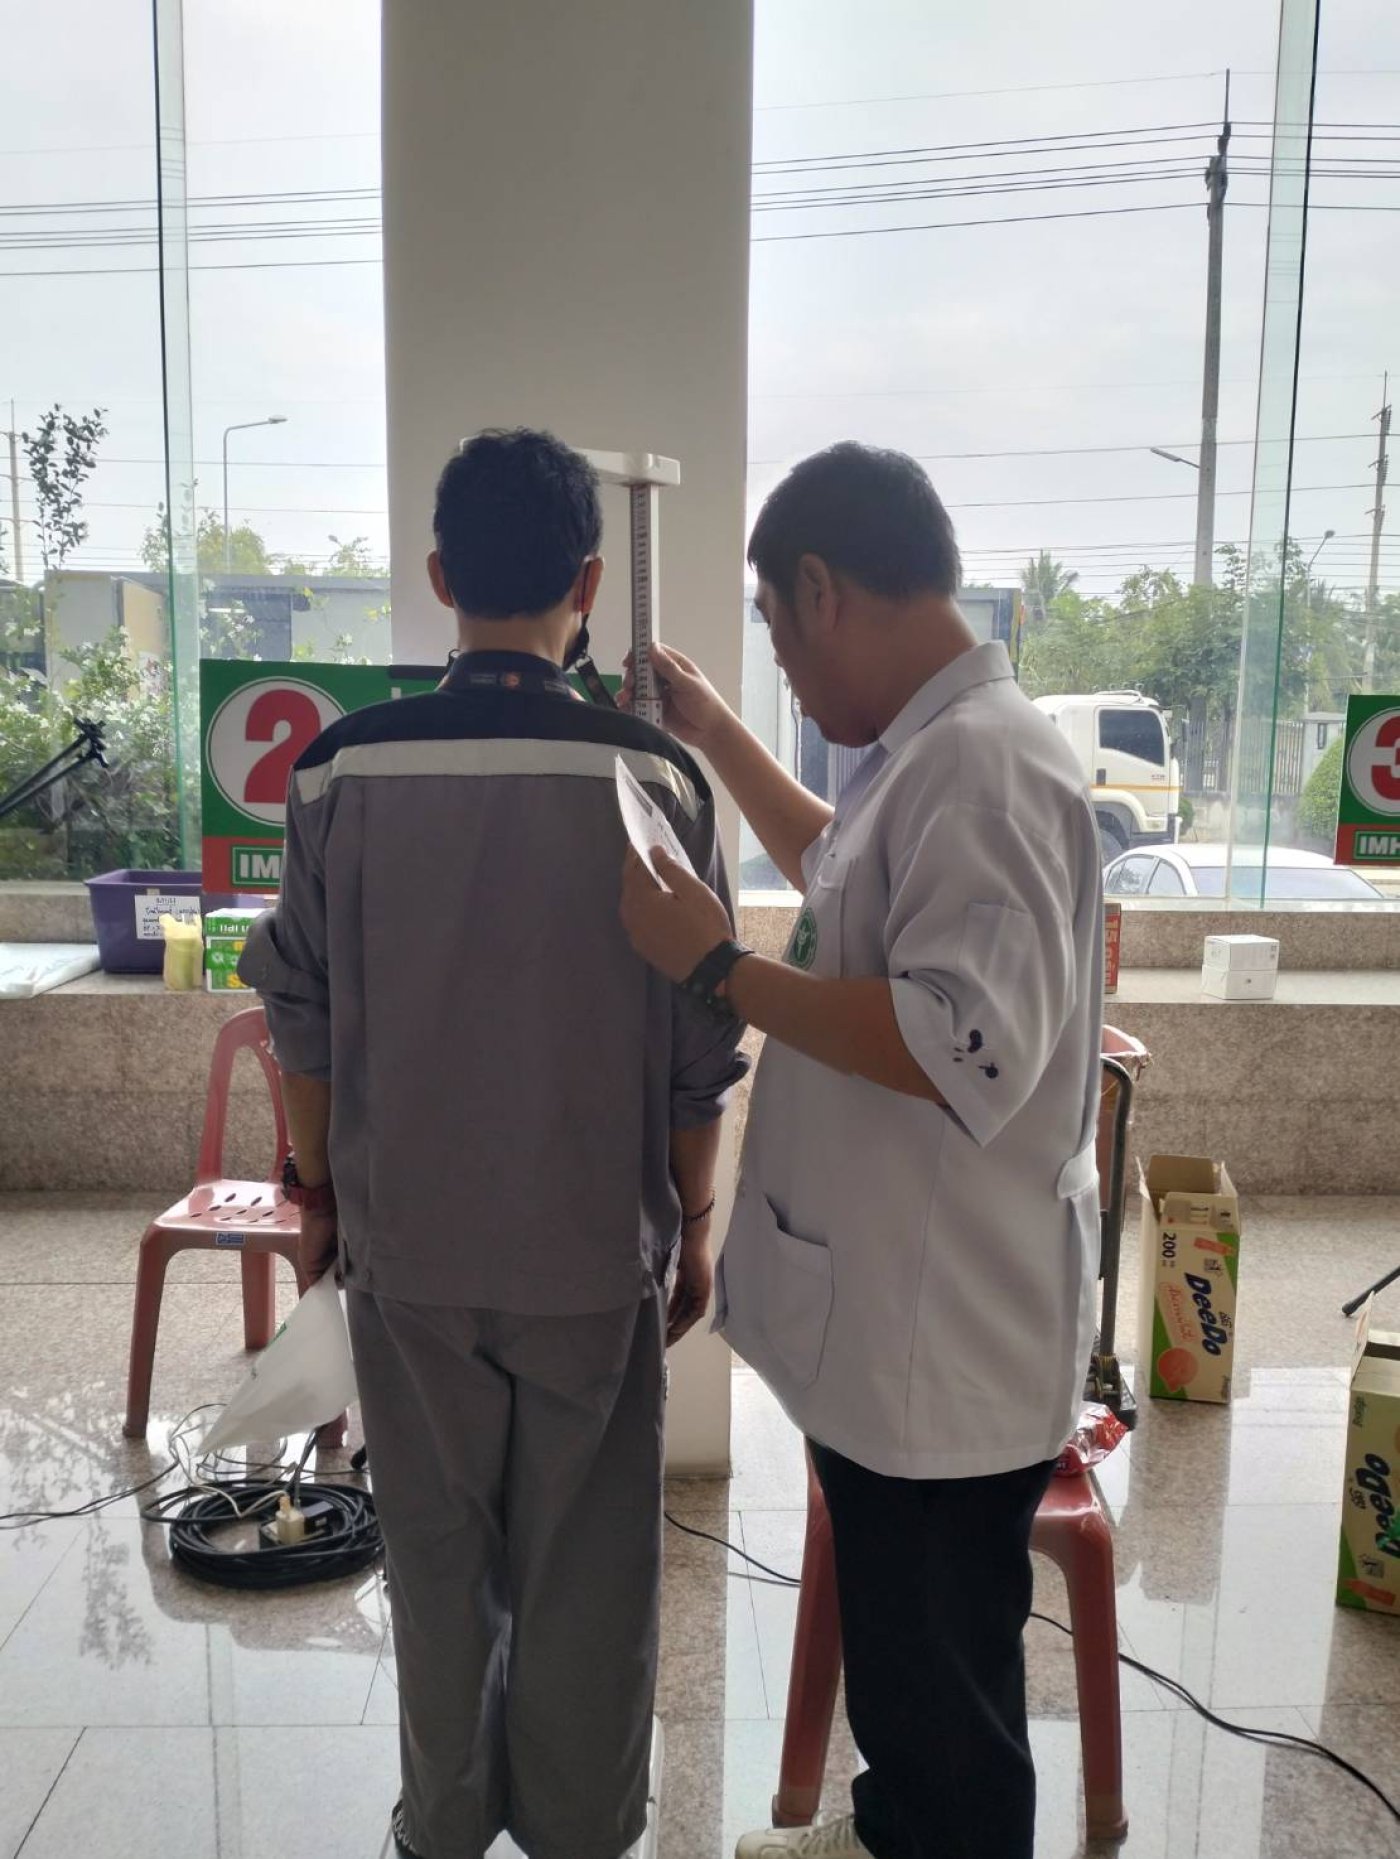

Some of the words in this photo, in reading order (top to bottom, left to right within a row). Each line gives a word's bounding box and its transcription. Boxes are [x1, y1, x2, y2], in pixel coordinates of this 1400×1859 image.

[243, 689, 322, 803] 2
[240, 854, 280, 879] IM
[1162, 1232, 1176, 1258] 200
[1184, 1272, 1228, 1356] DeeDo
